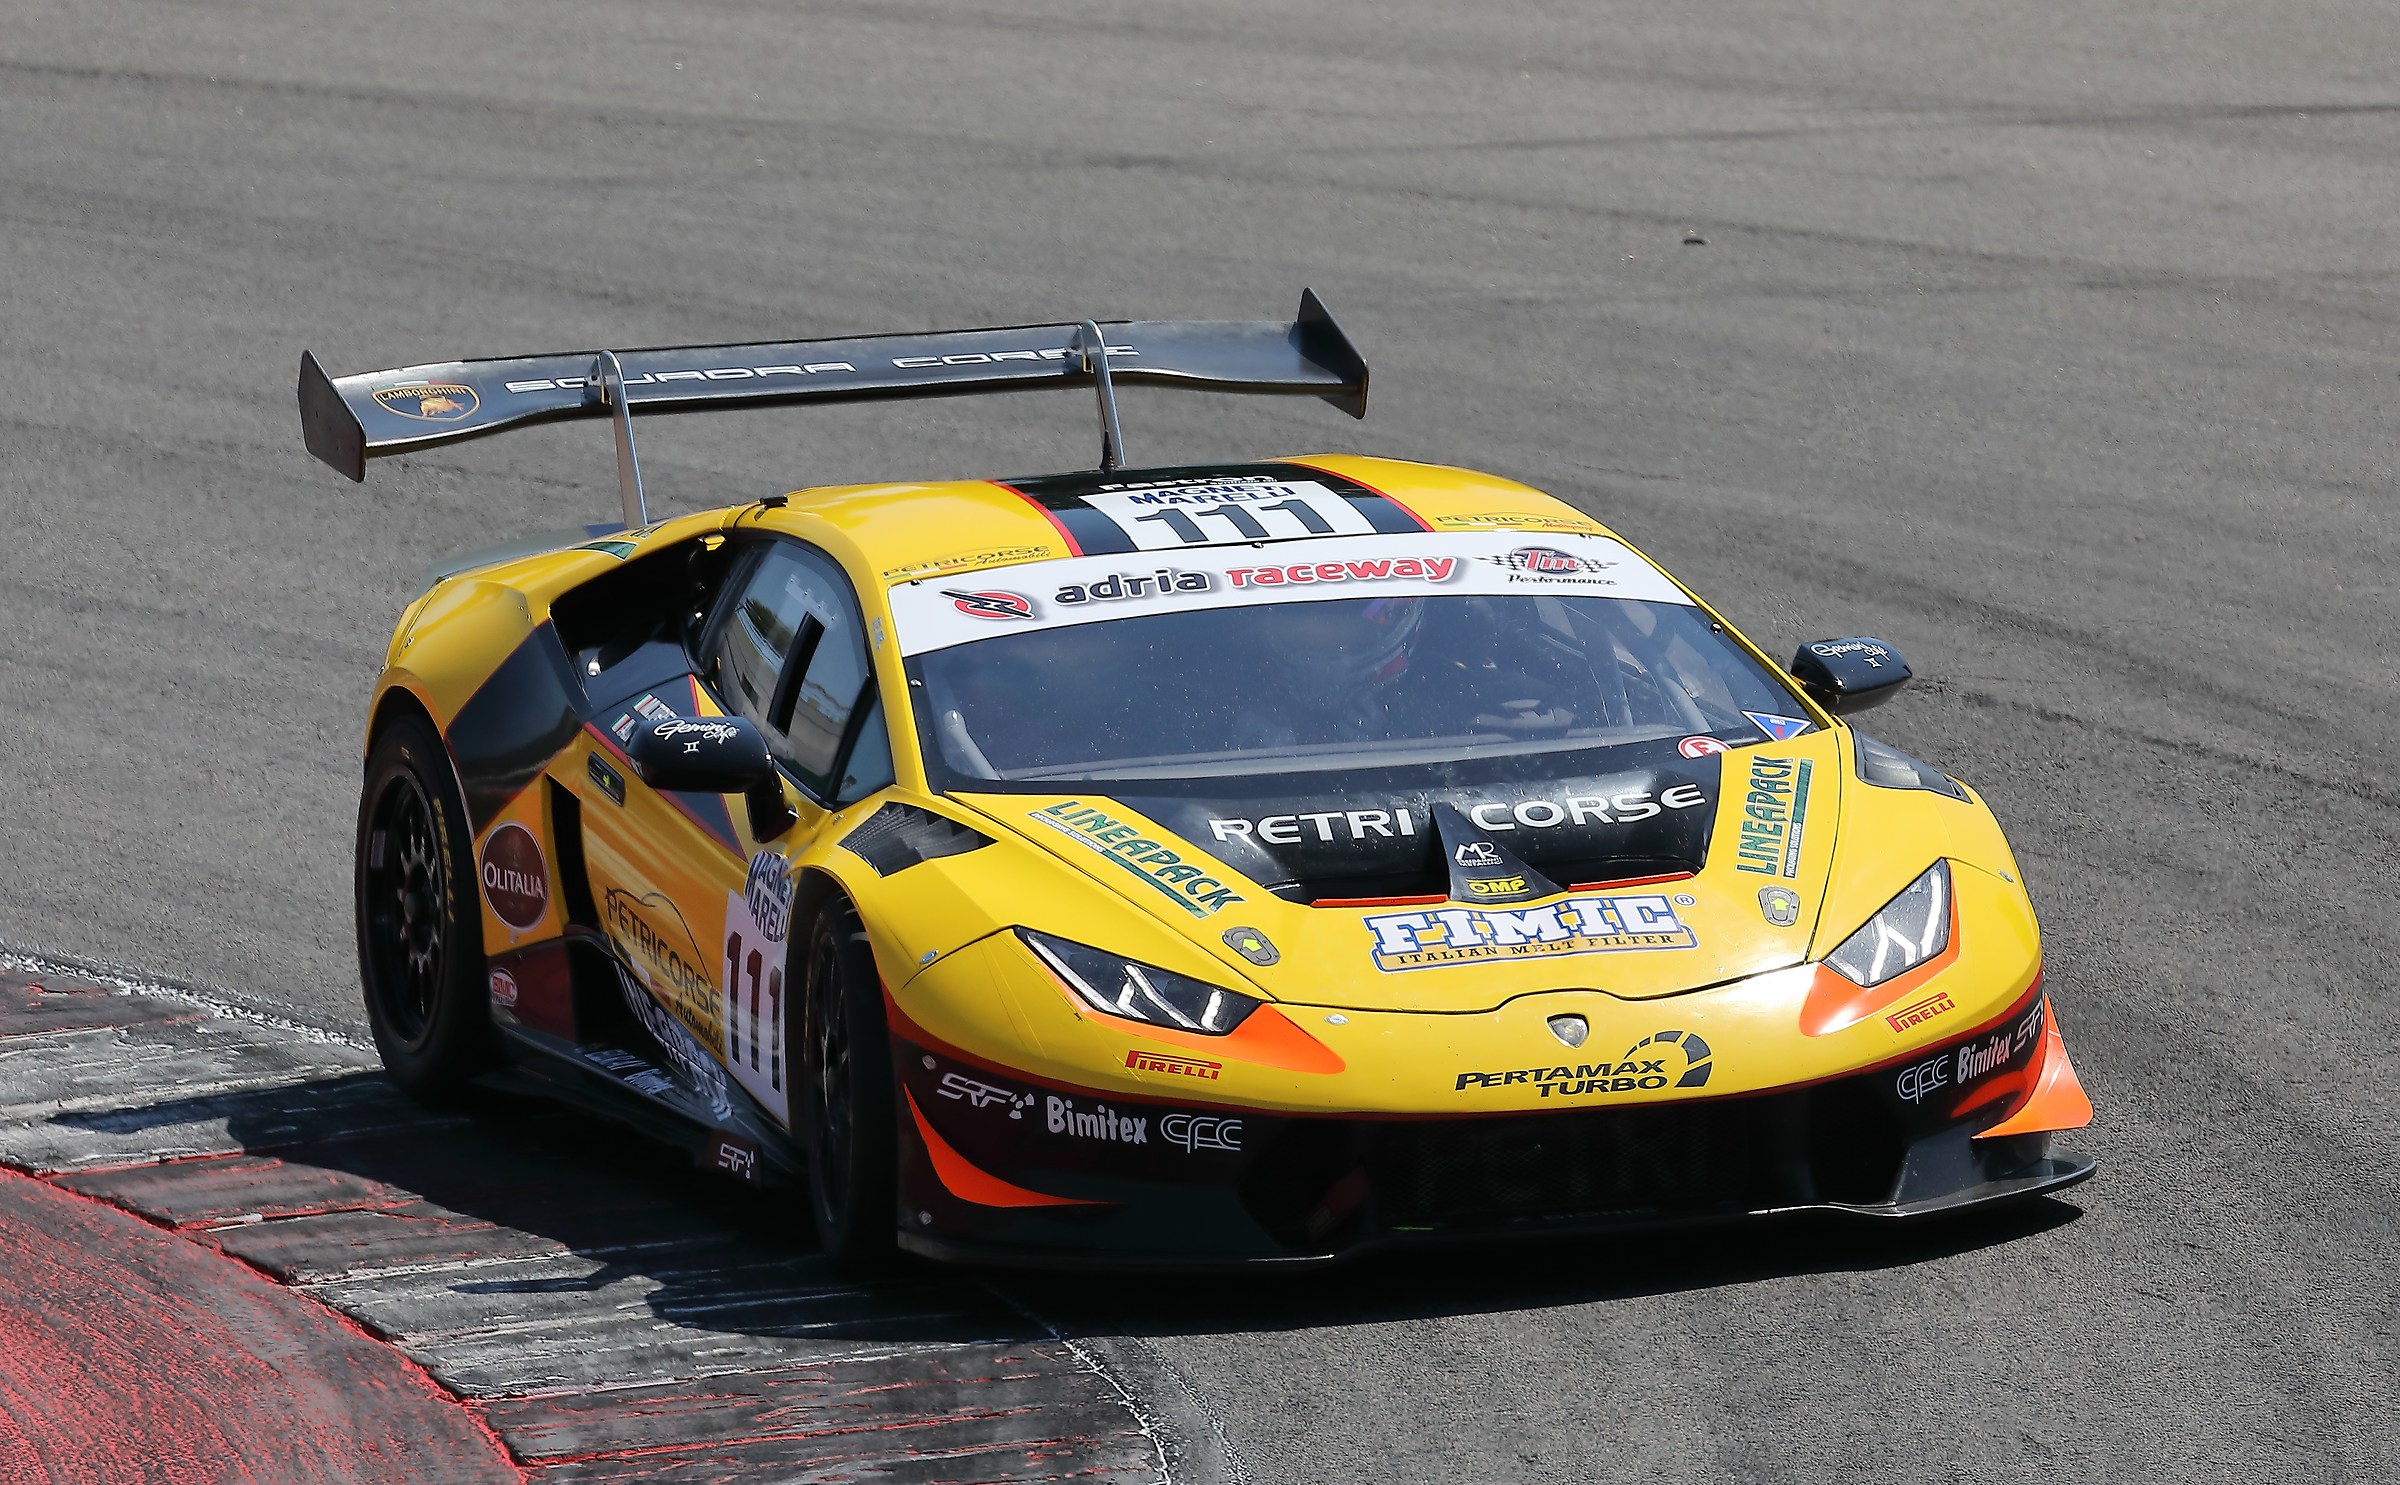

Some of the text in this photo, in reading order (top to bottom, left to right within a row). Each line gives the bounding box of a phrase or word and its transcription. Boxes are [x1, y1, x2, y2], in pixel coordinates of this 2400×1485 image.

[1134, 499, 1337, 544] 111
[1054, 557, 1456, 604] adria raceway
[1507, 573, 1618, 586] Performance
[1468, 782, 1706, 832] CORSE
[1735, 754, 1795, 877] LINEAPACK
[1042, 799, 1248, 913] LINEAPACK
[484, 861, 546, 900] OLITALIA
[1468, 879, 1526, 893] OMP
[1362, 894, 1685, 955] FIMIC
[605, 891, 723, 1026] PETRICORSE
[1397, 935, 1675, 965] ITALIAN MELT FILTER
[726, 930, 781, 1094] 111
[1885, 991, 1957, 1034] PIRELLI
[1124, 1049, 1224, 1081] PIRELLI
[1455, 1059, 1668, 1092] PERTAMAX
[1956, 1032, 2012, 1085] Bimitex
[1535, 1075, 1669, 1098] TURBO
[1046, 1094, 1148, 1145] Bimitex
